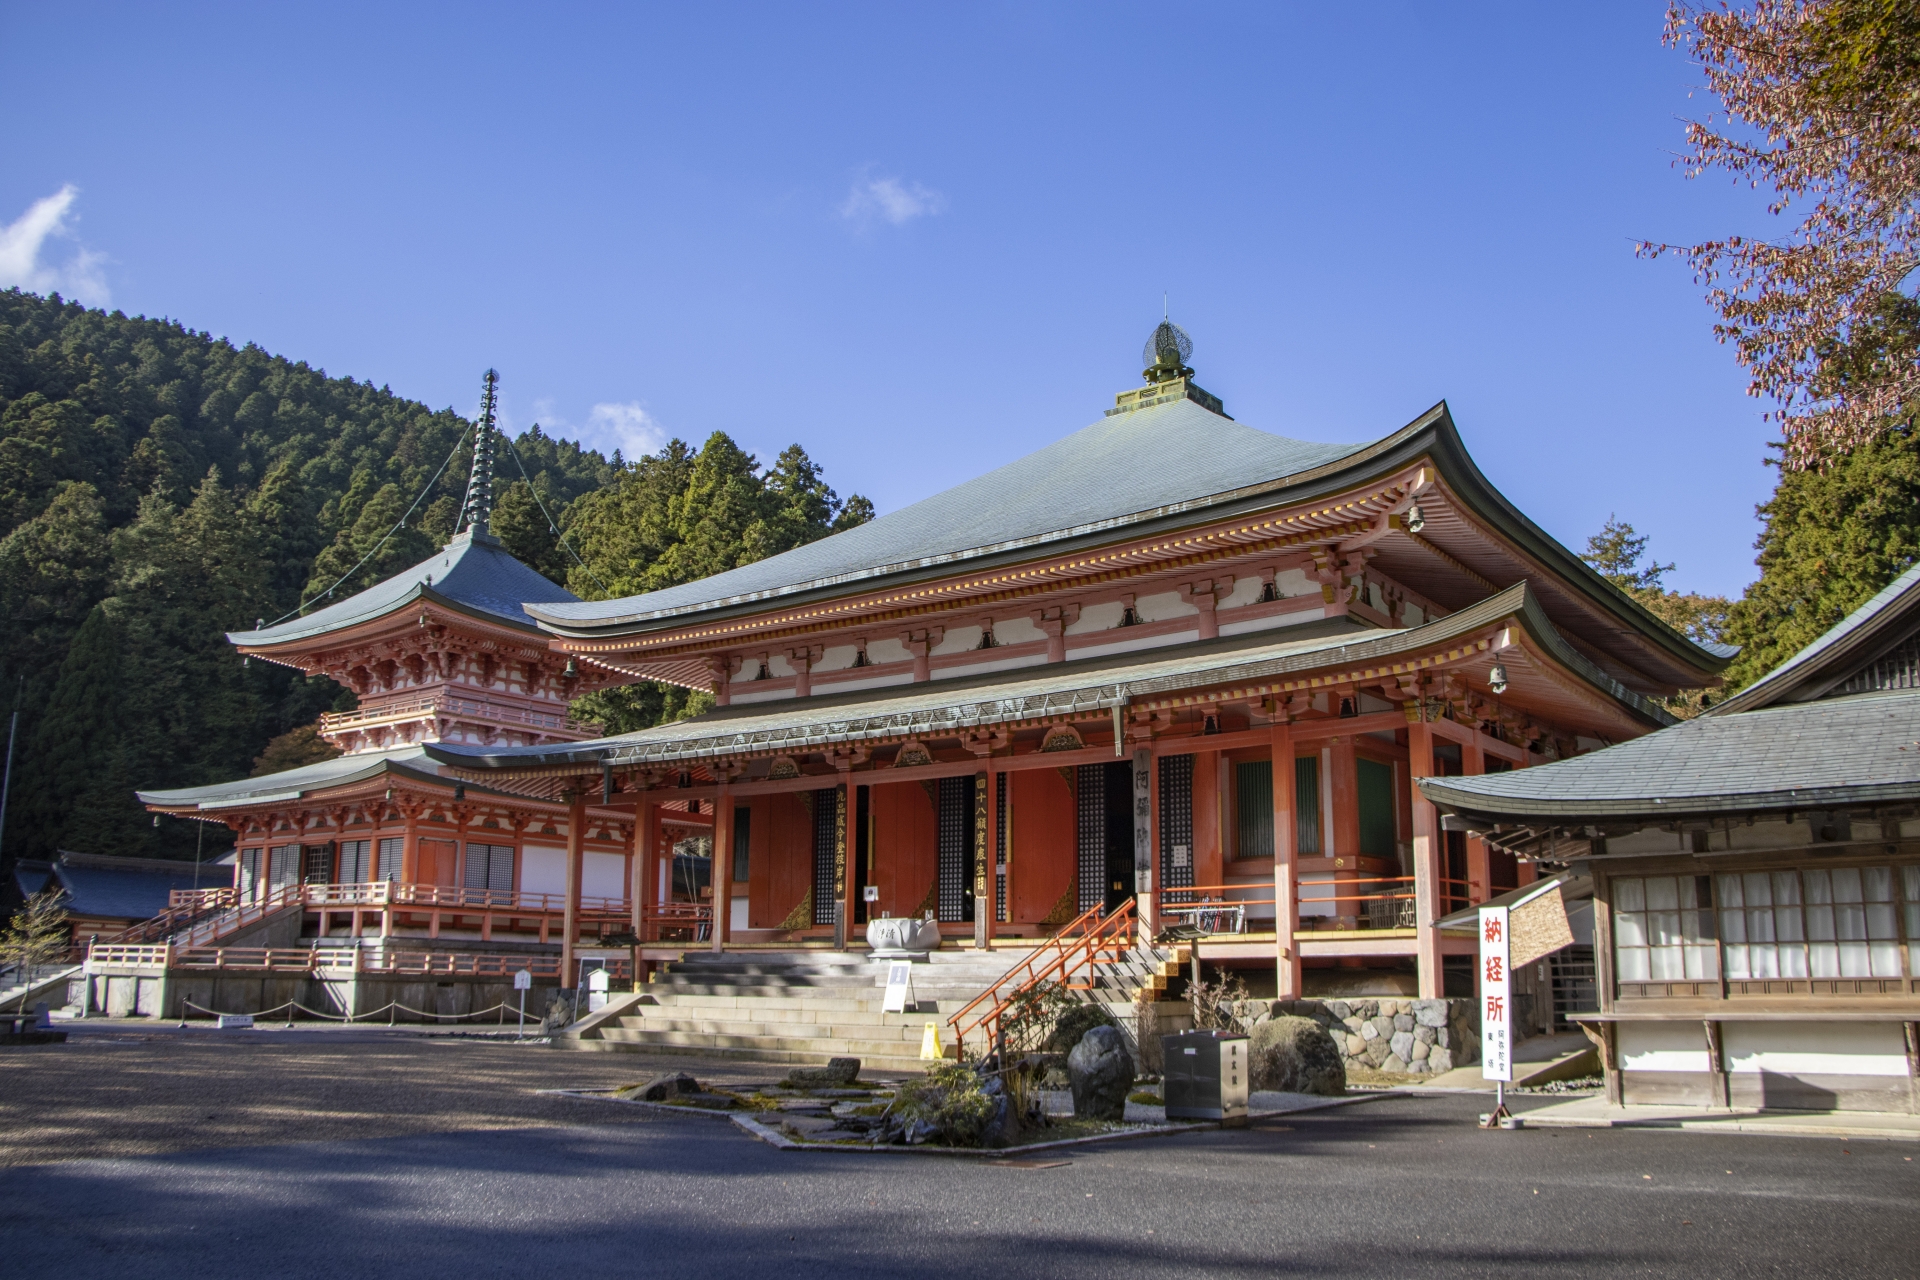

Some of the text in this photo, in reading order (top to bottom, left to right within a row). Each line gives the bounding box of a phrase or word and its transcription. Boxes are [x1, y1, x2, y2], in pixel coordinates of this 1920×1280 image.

[1485, 916, 1503, 1023] 納経所
[1497, 1029, 1505, 1073] 阿弥陀堂
